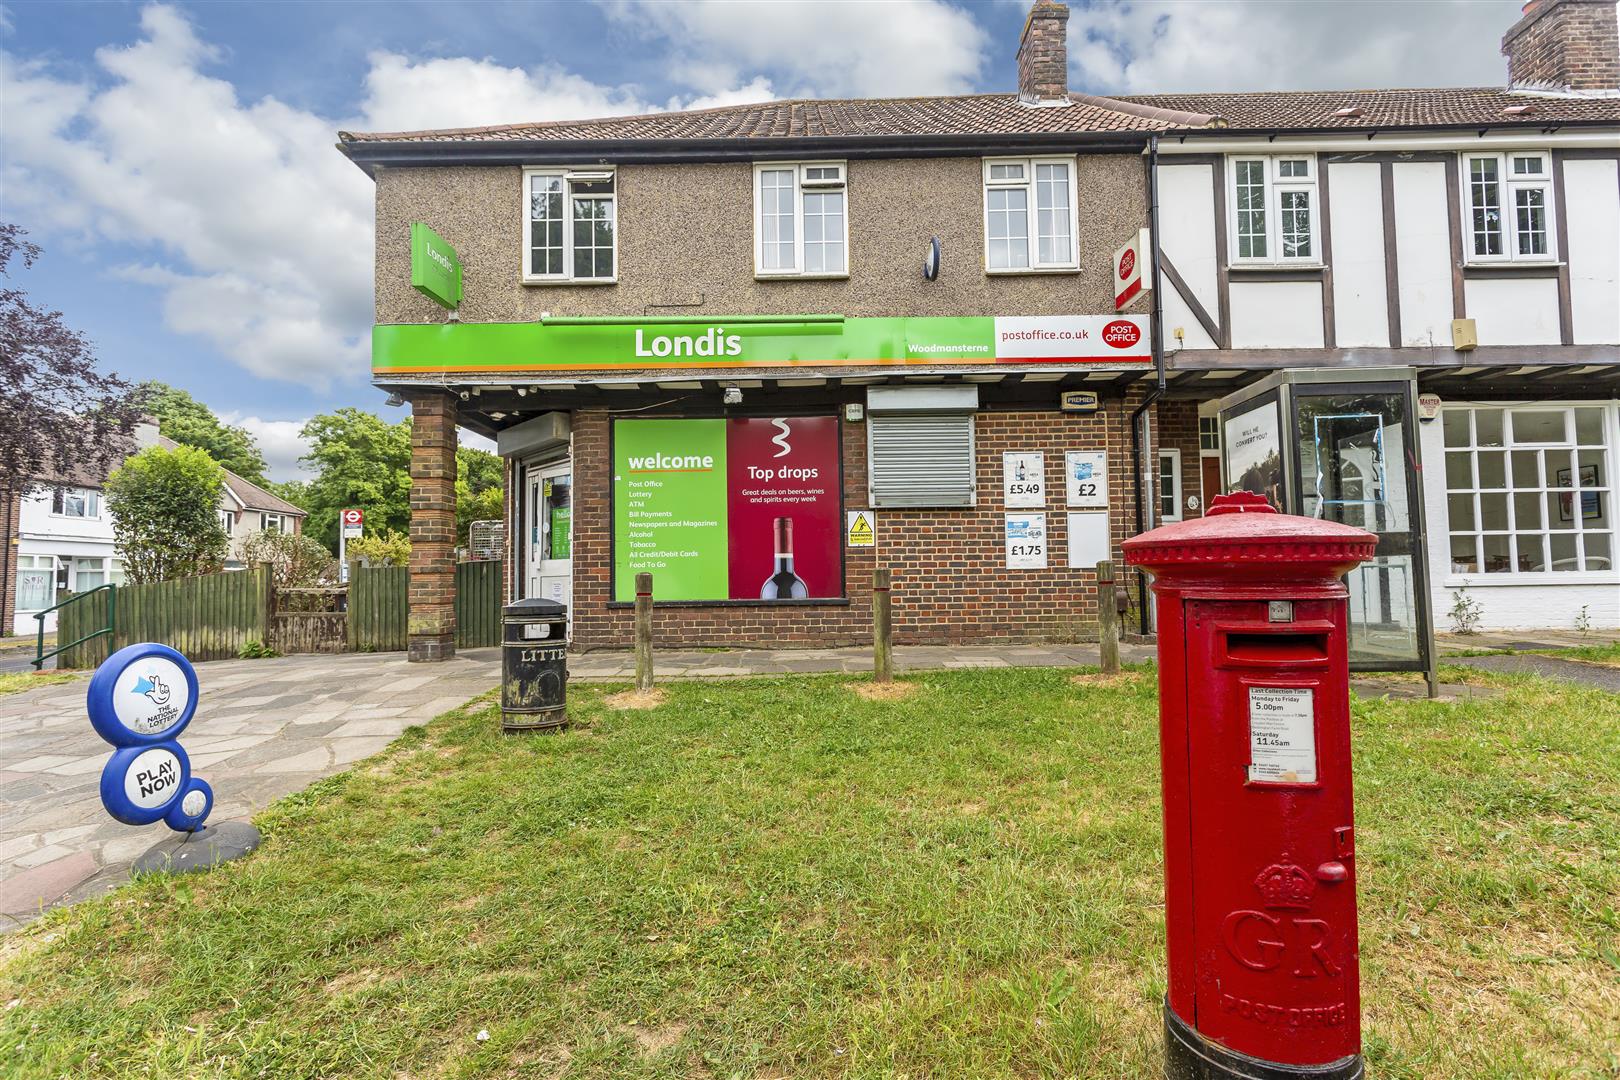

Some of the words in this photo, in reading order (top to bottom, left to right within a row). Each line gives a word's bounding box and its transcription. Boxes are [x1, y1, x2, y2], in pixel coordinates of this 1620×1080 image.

[427, 241, 453, 272] Londis
[1002, 329, 1089, 342] postoffice.co.uk
[1110, 326, 1133, 334] POST
[635, 327, 742, 357] Londis
[1106, 333, 1137, 342] OFFICE
[908, 344, 988, 353] Woodmansterne
[1242, 428, 1252, 436] WILL
[1235, 436, 1255, 448] CONVERT
[628, 452, 714, 469] welcome
[747, 466, 774, 482] Top
[778, 465, 818, 481] drops
[644, 480, 663, 488] Office
[1010, 484, 1040, 494] £5.49
[628, 491, 652, 499] Lottery
[742, 488, 760, 496] Great
[1078, 483, 1096, 497] £2
[763, 496, 782, 504] spirits
[783, 496, 800, 504] every
[640, 511, 673, 519] Payments
[628, 521, 668, 529] Newspapers
[683, 520, 718, 528] Magazines
[1011, 545, 1042, 556] £1.75
[521, 648, 567, 662] LITTE
[158, 704, 171, 714] THE
[1255, 702, 1283, 711] 5.00pm
[147, 707, 179, 723] NATIONAL
[149, 713, 178, 728] LOTTERY
[1256, 737, 1290, 747] 11.45am
[136, 760, 173, 786] PLAY
[140, 771, 176, 799] NOW
[1222, 909, 1342, 977] GR
[1223, 993, 1284, 1023] POST
[1288, 1002, 1345, 1027] OFFICE
